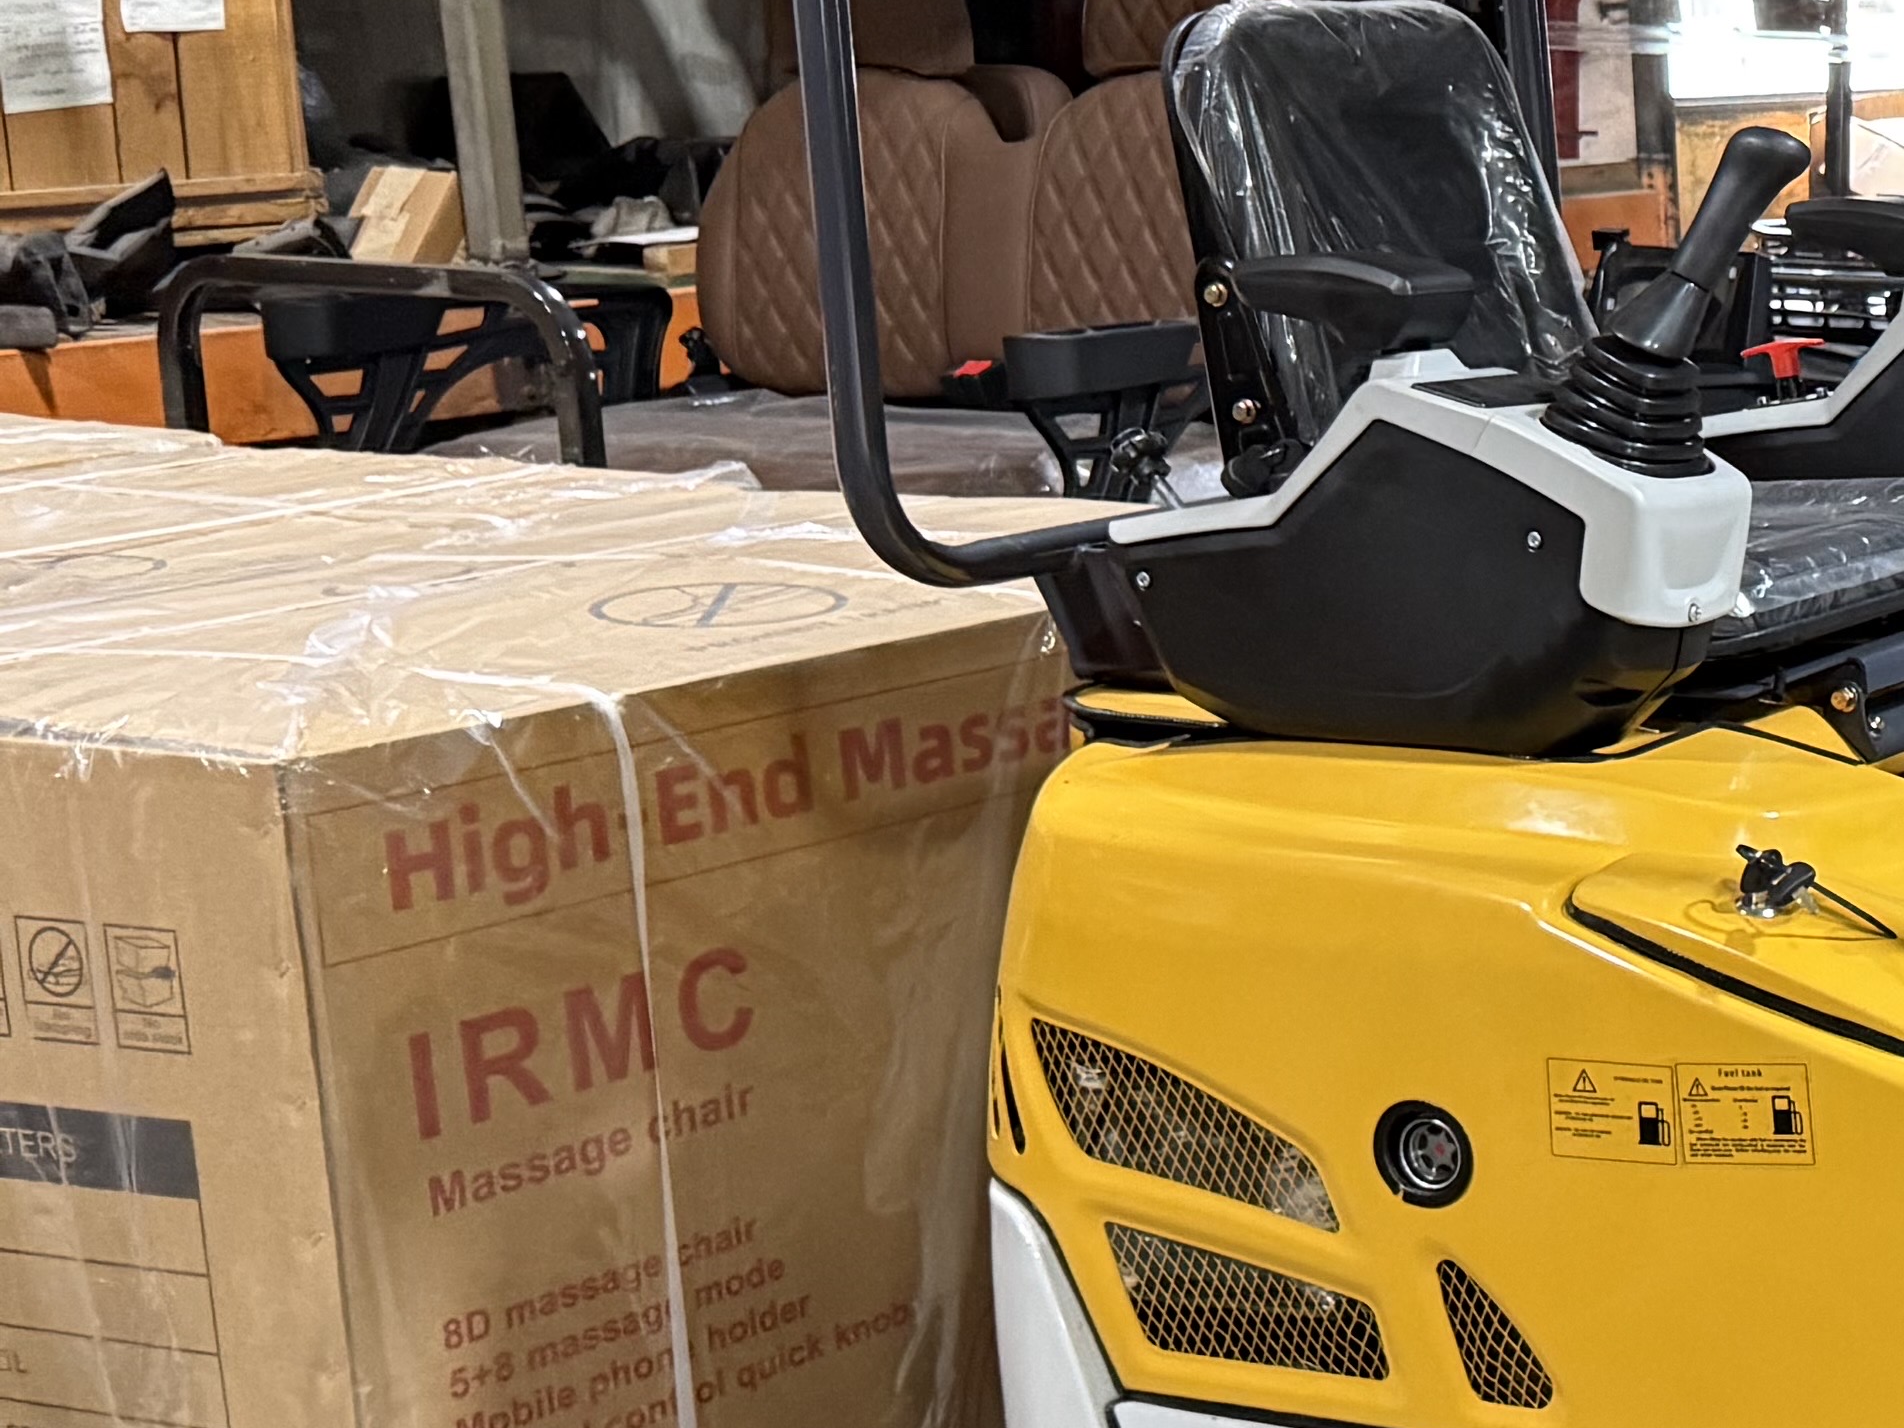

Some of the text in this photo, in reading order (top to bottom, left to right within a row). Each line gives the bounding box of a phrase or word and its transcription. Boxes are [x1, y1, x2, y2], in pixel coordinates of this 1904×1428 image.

[839, 697, 1070, 802] Massa
[408, 946, 754, 1140] IRMC
[0, 1126, 77, 1162] TERS
[427, 1082, 754, 1217] Massage chair
[443, 1216, 757, 1350] 8D massage chair
[528, 1298, 671, 1371] massag
[695, 1258, 785, 1310] mode
[708, 1294, 811, 1352] holder
[736, 1334, 824, 1391] quick
[834, 1300, 912, 1350] knob
